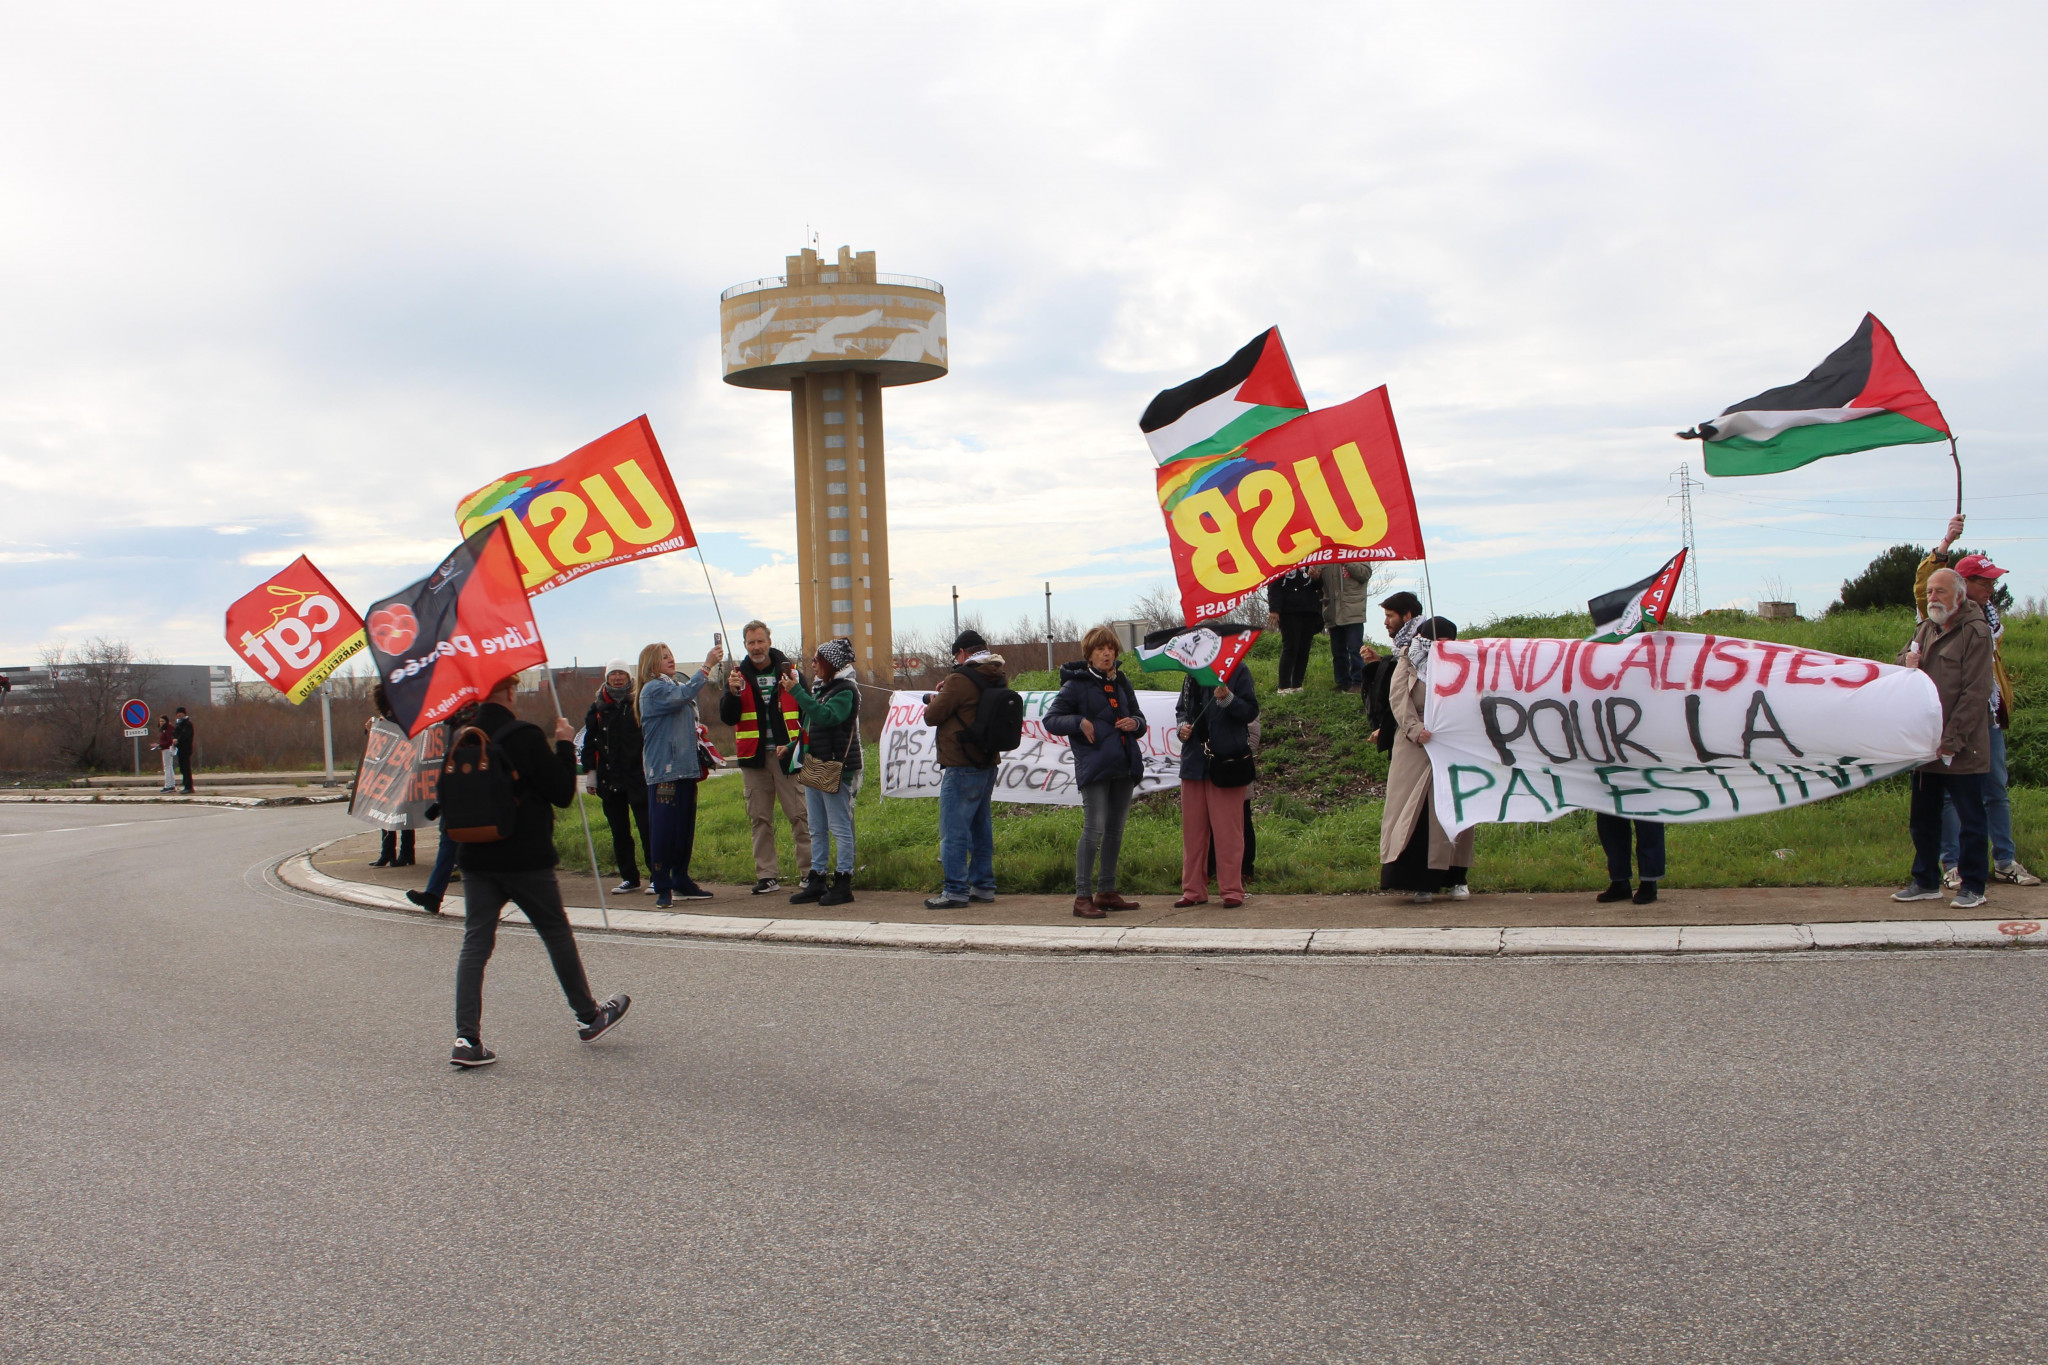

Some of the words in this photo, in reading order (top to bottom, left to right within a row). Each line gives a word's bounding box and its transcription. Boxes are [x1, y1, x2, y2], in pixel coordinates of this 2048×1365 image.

[1434, 634, 1880, 697] SYNDICALISTES
[888, 729, 927, 761] PAS
[1480, 696, 1662, 766] POUR
[1684, 689, 1804, 763] LA
[885, 760, 906, 790] ET
[907, 759, 943, 789] LES
